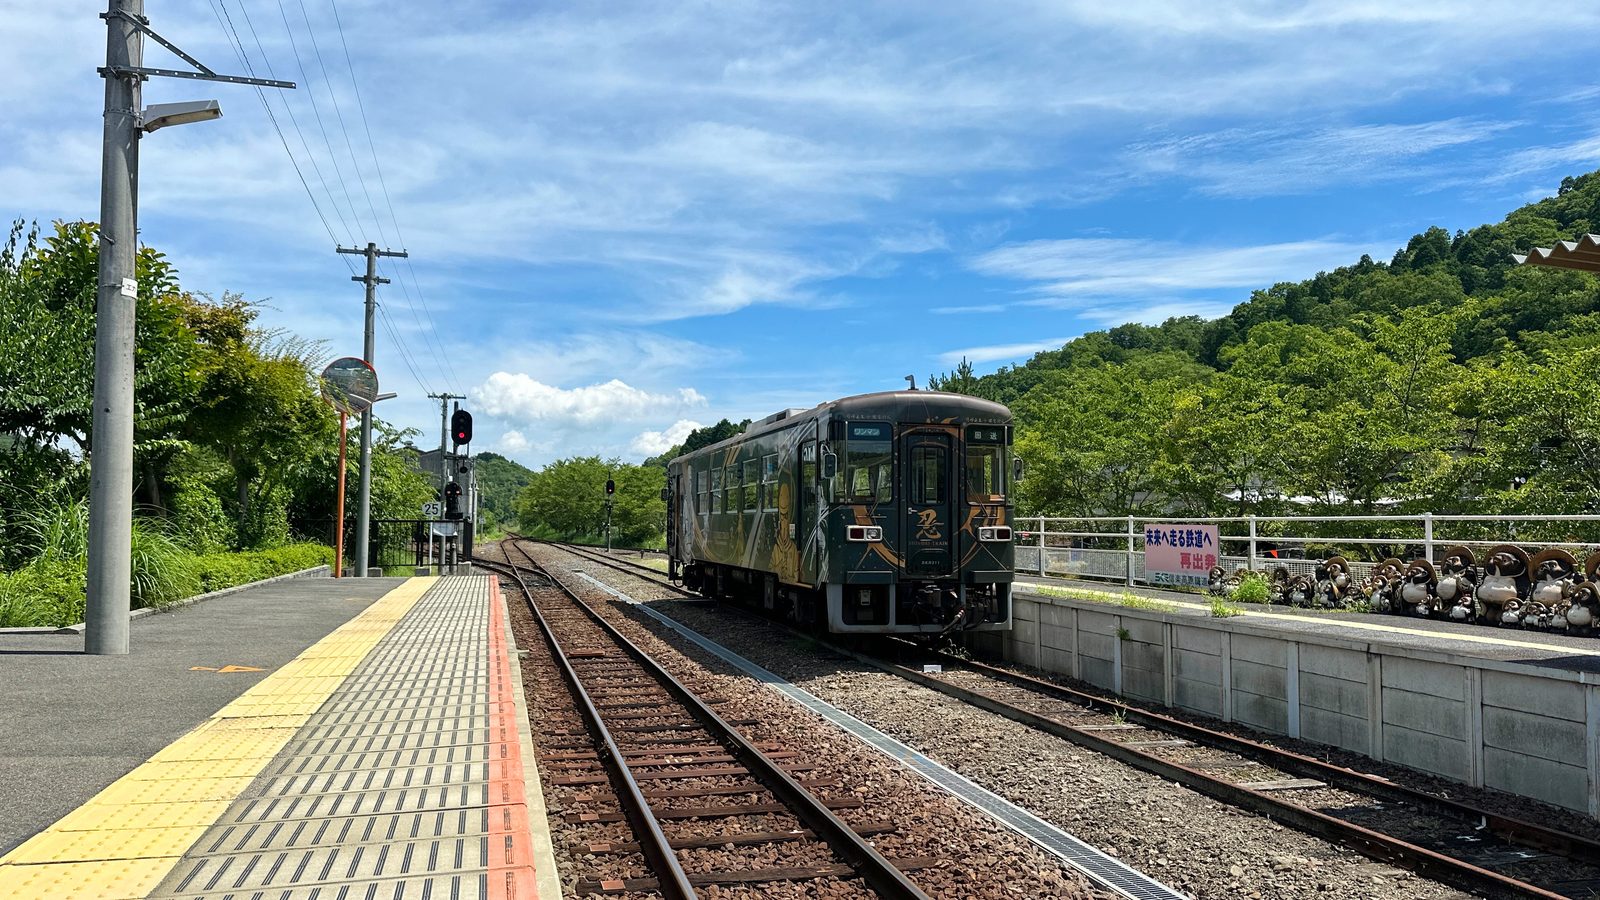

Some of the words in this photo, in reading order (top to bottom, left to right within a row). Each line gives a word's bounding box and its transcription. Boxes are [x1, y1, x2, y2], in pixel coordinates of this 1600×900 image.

[854, 428, 880, 436] ワンマン
[426, 504, 438, 515] 25
[1147, 529, 1212, 548] 未来へ走る鉄道へ
[1180, 552, 1216, 571] 再出発
